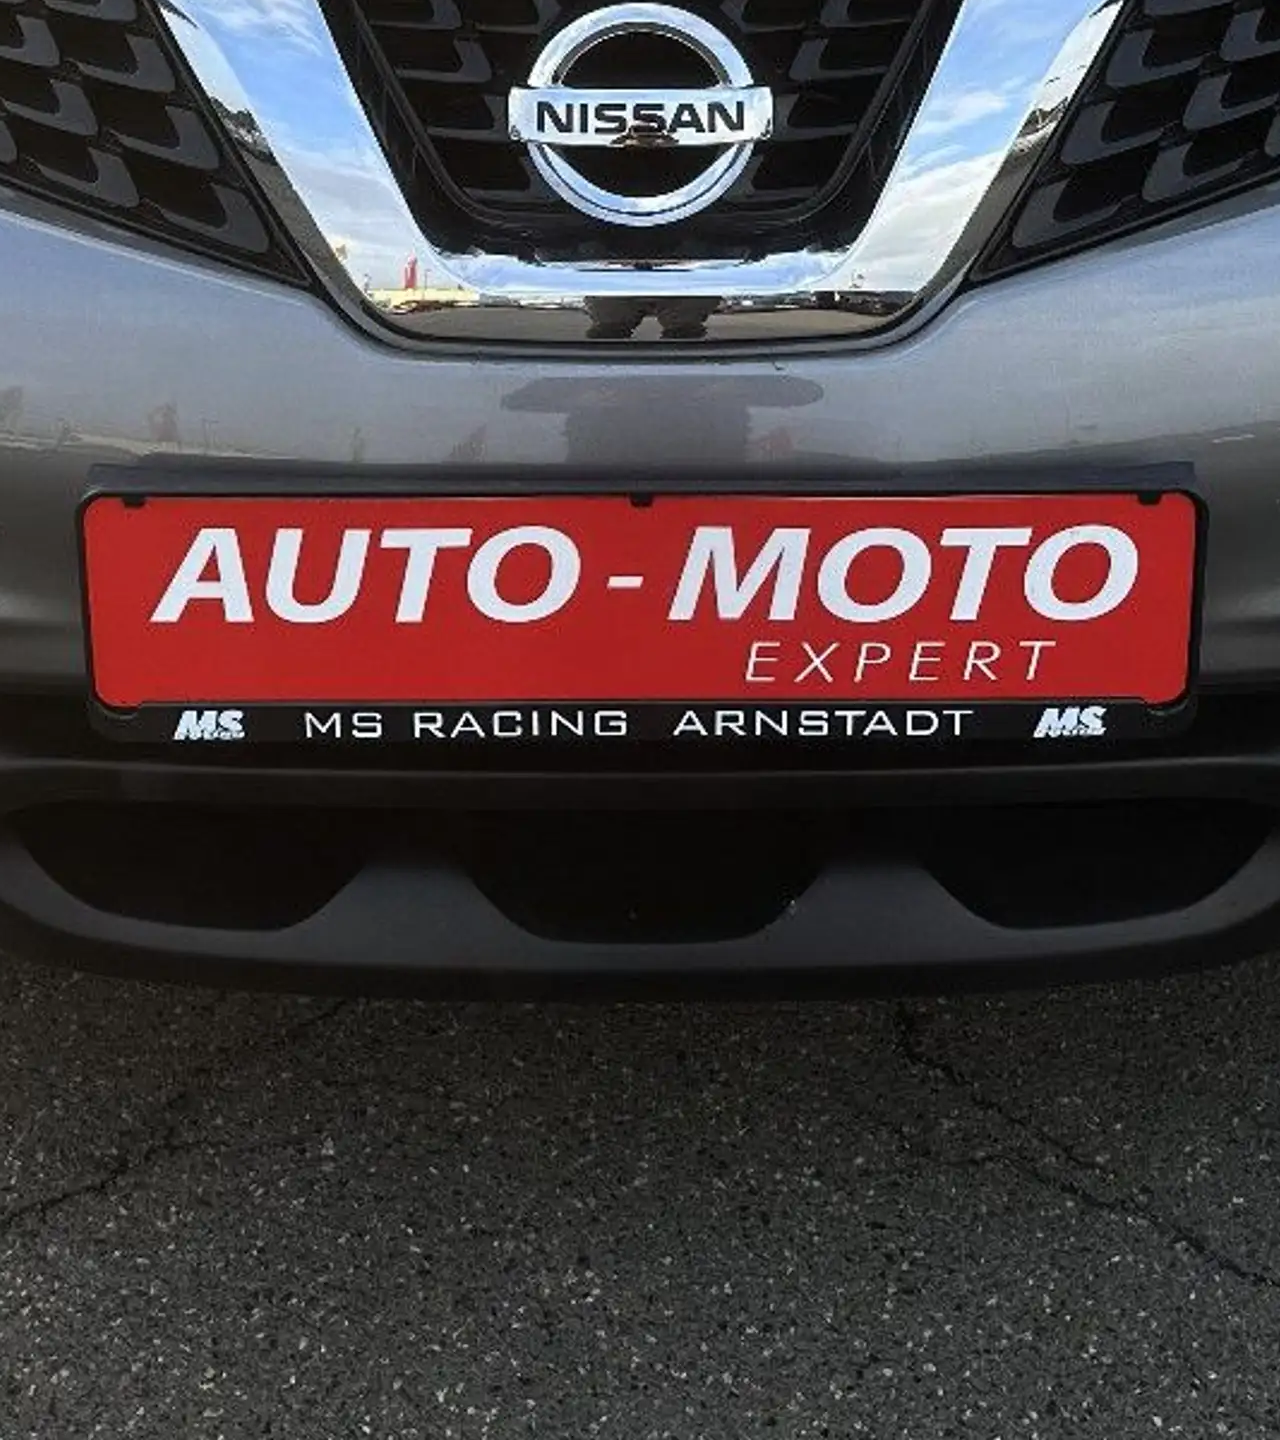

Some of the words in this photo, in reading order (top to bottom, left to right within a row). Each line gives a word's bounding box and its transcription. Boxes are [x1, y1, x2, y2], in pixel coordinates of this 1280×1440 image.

[536, 101, 744, 135] NISSAN
[149, 526, 582, 623] AUTO
[667, 524, 1139, 622] MOTO
[745, 641, 1057, 682] EXPERT
[173, 710, 246, 741] MS
[305, 712, 383, 738] MS
[414, 710, 628, 738] RACING
[673, 710, 974, 737] ARNSTADT
[1033, 706, 1108, 739] MS
